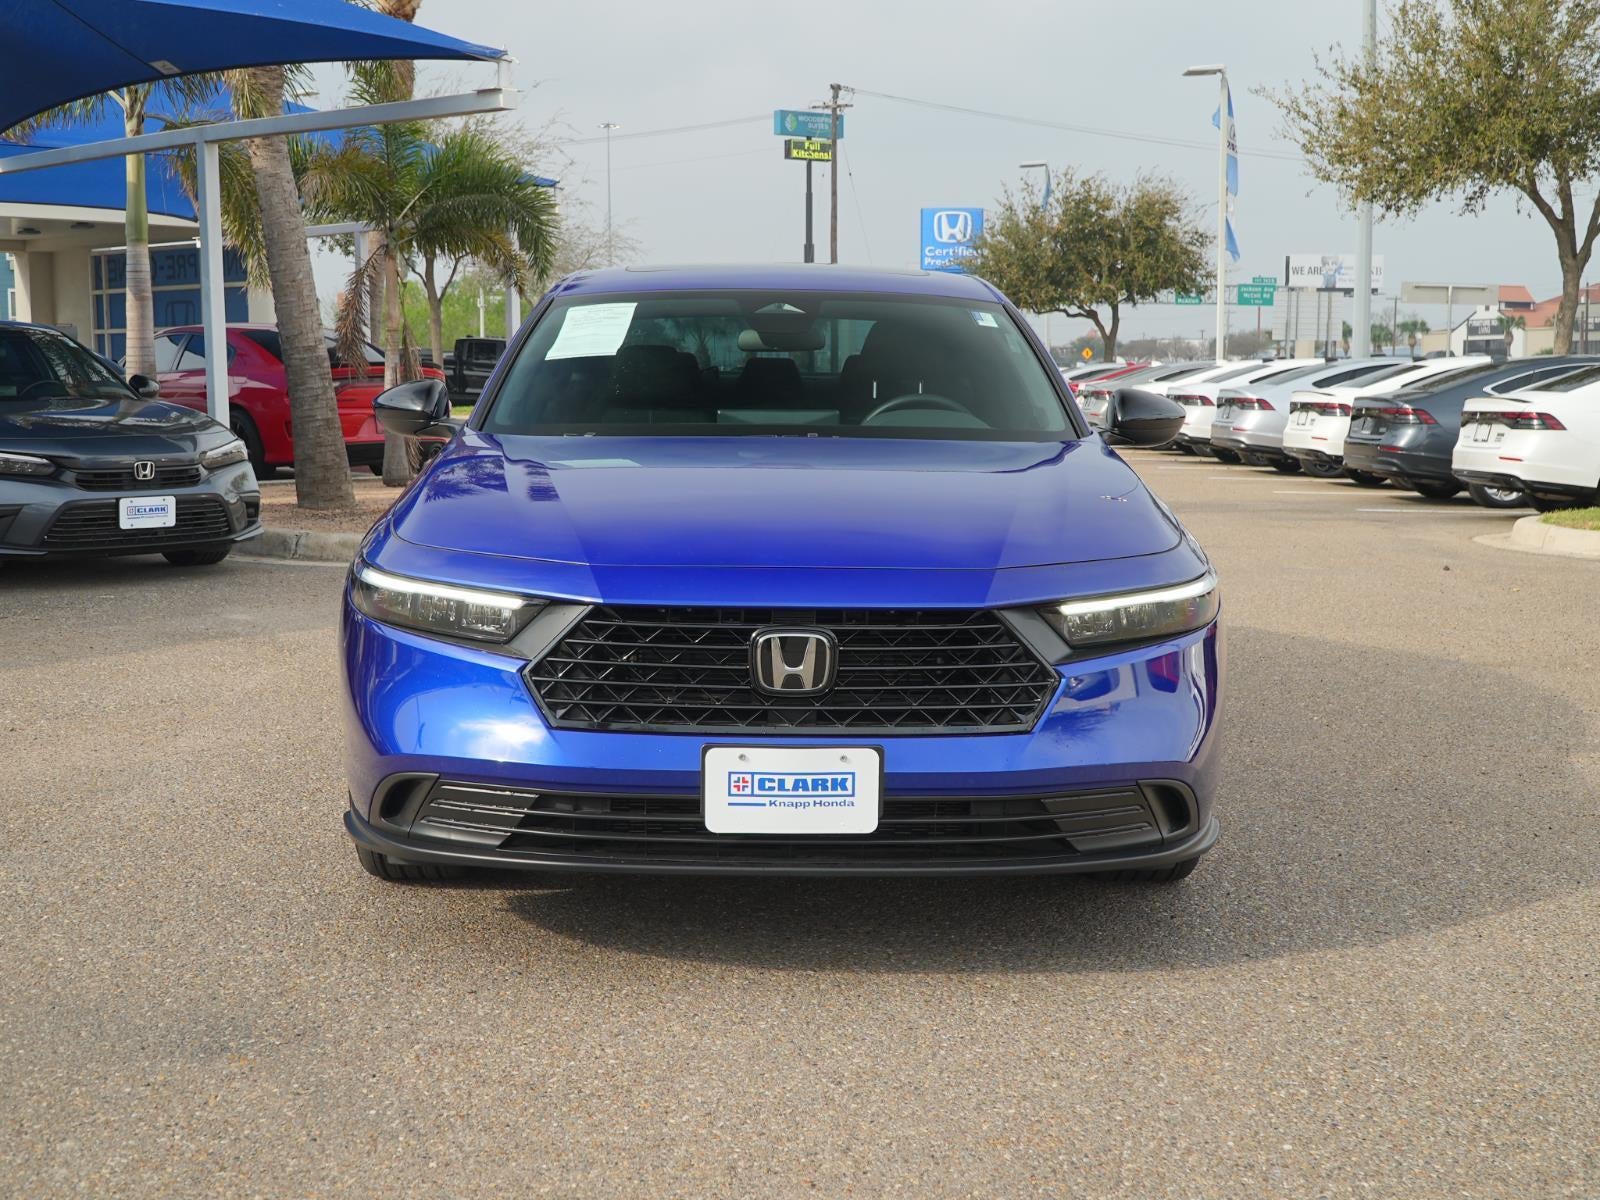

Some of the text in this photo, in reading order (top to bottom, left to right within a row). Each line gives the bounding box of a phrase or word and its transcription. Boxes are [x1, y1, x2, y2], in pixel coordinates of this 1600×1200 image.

[804, 141, 821, 150] Full
[1292, 266, 1323, 275] WE ARE
[757, 777, 849, 792] CLARK
[769, 799, 855, 809] Knapp Honda
